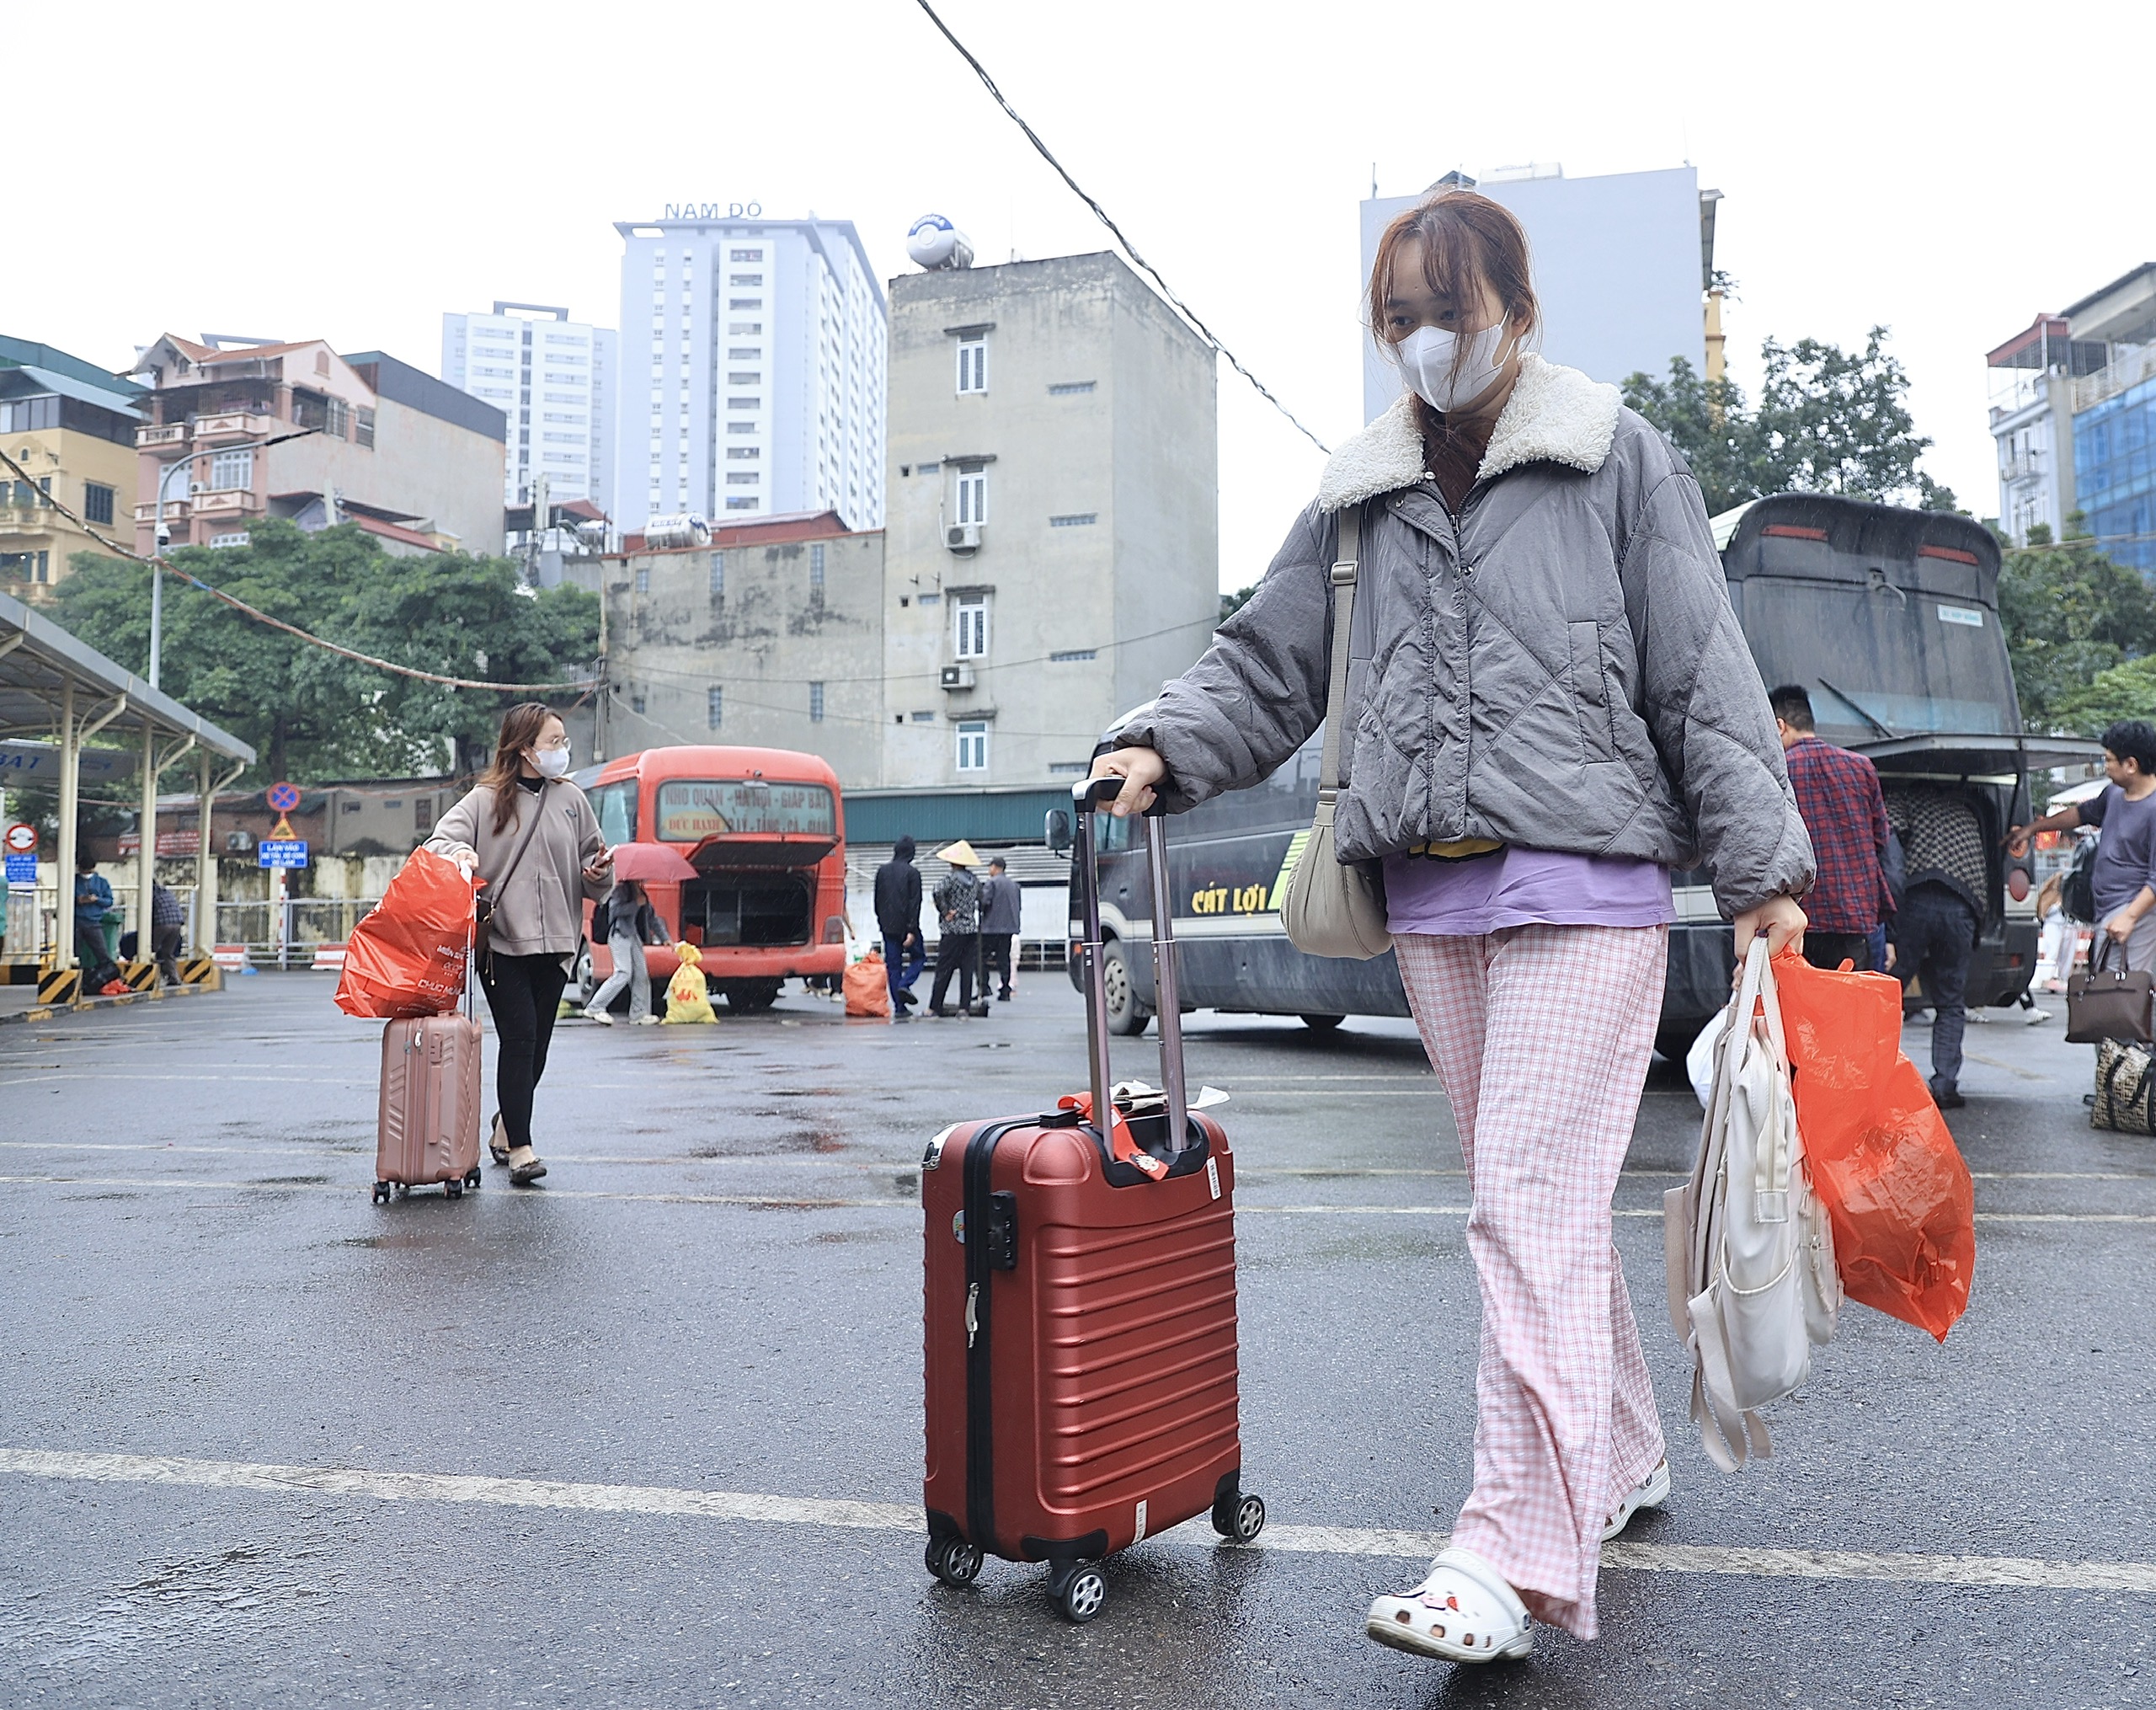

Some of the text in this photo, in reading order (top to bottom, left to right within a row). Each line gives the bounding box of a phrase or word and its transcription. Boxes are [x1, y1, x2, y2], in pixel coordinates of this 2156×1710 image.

[664, 202, 718, 219] NAM
[1191, 880, 1267, 917] CÁT LỢI
